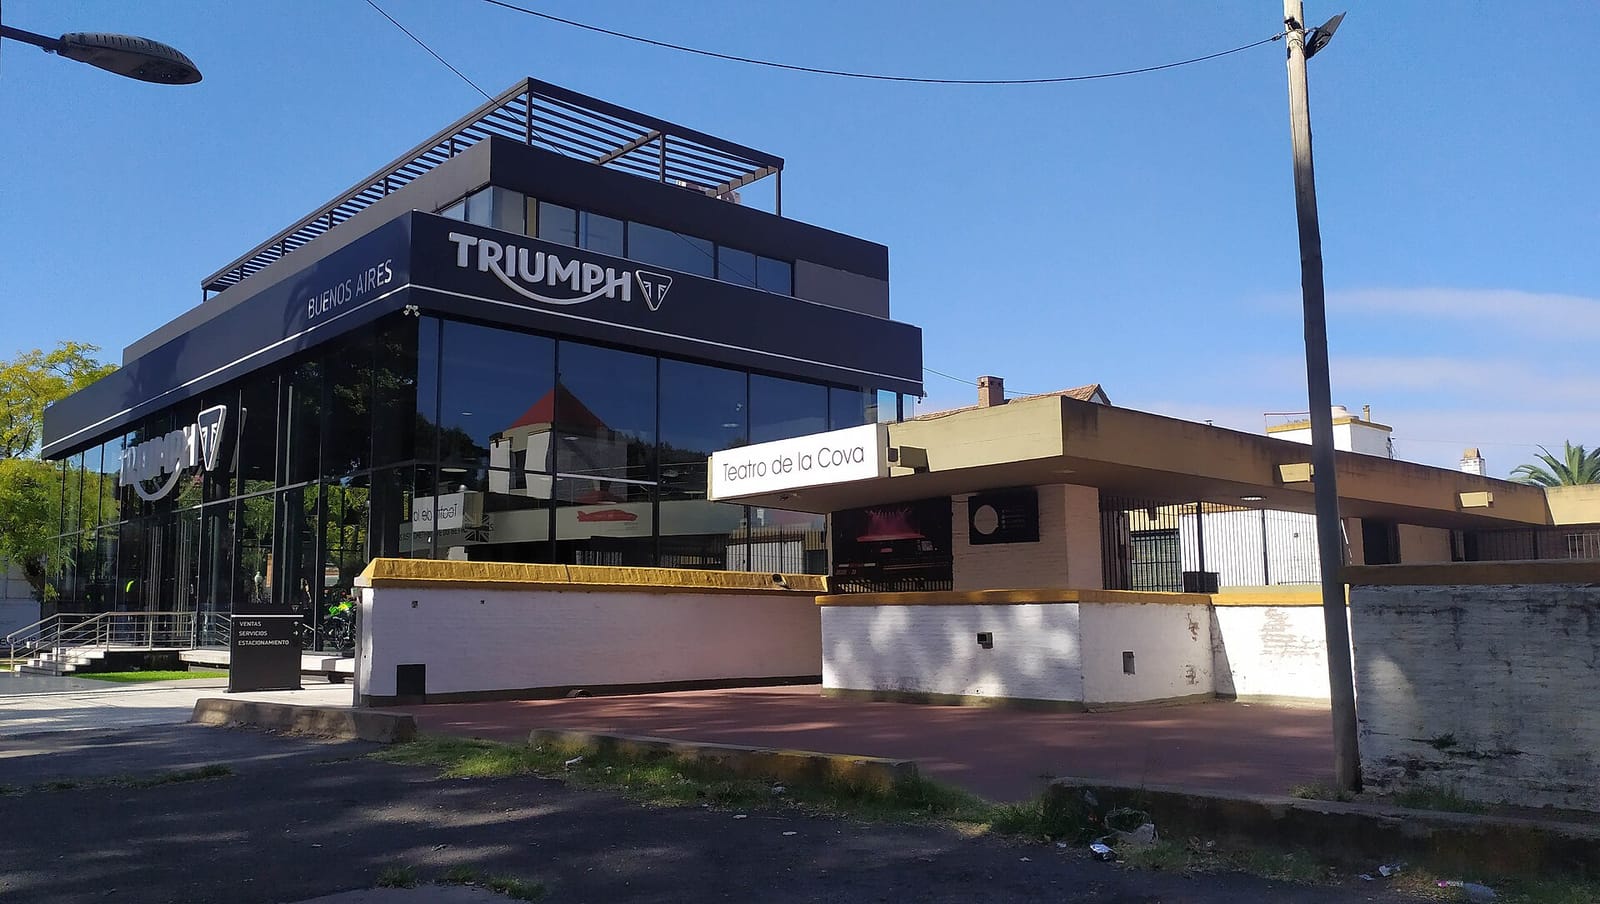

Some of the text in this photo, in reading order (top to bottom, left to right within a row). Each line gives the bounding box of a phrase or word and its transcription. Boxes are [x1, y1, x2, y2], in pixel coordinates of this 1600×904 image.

[308, 259, 392, 319] BUENOS AIRES
[449, 232, 631, 305] TRIUMPH
[119, 423, 199, 501] TRPH
[723, 446, 864, 481] Teatro de la Cova
